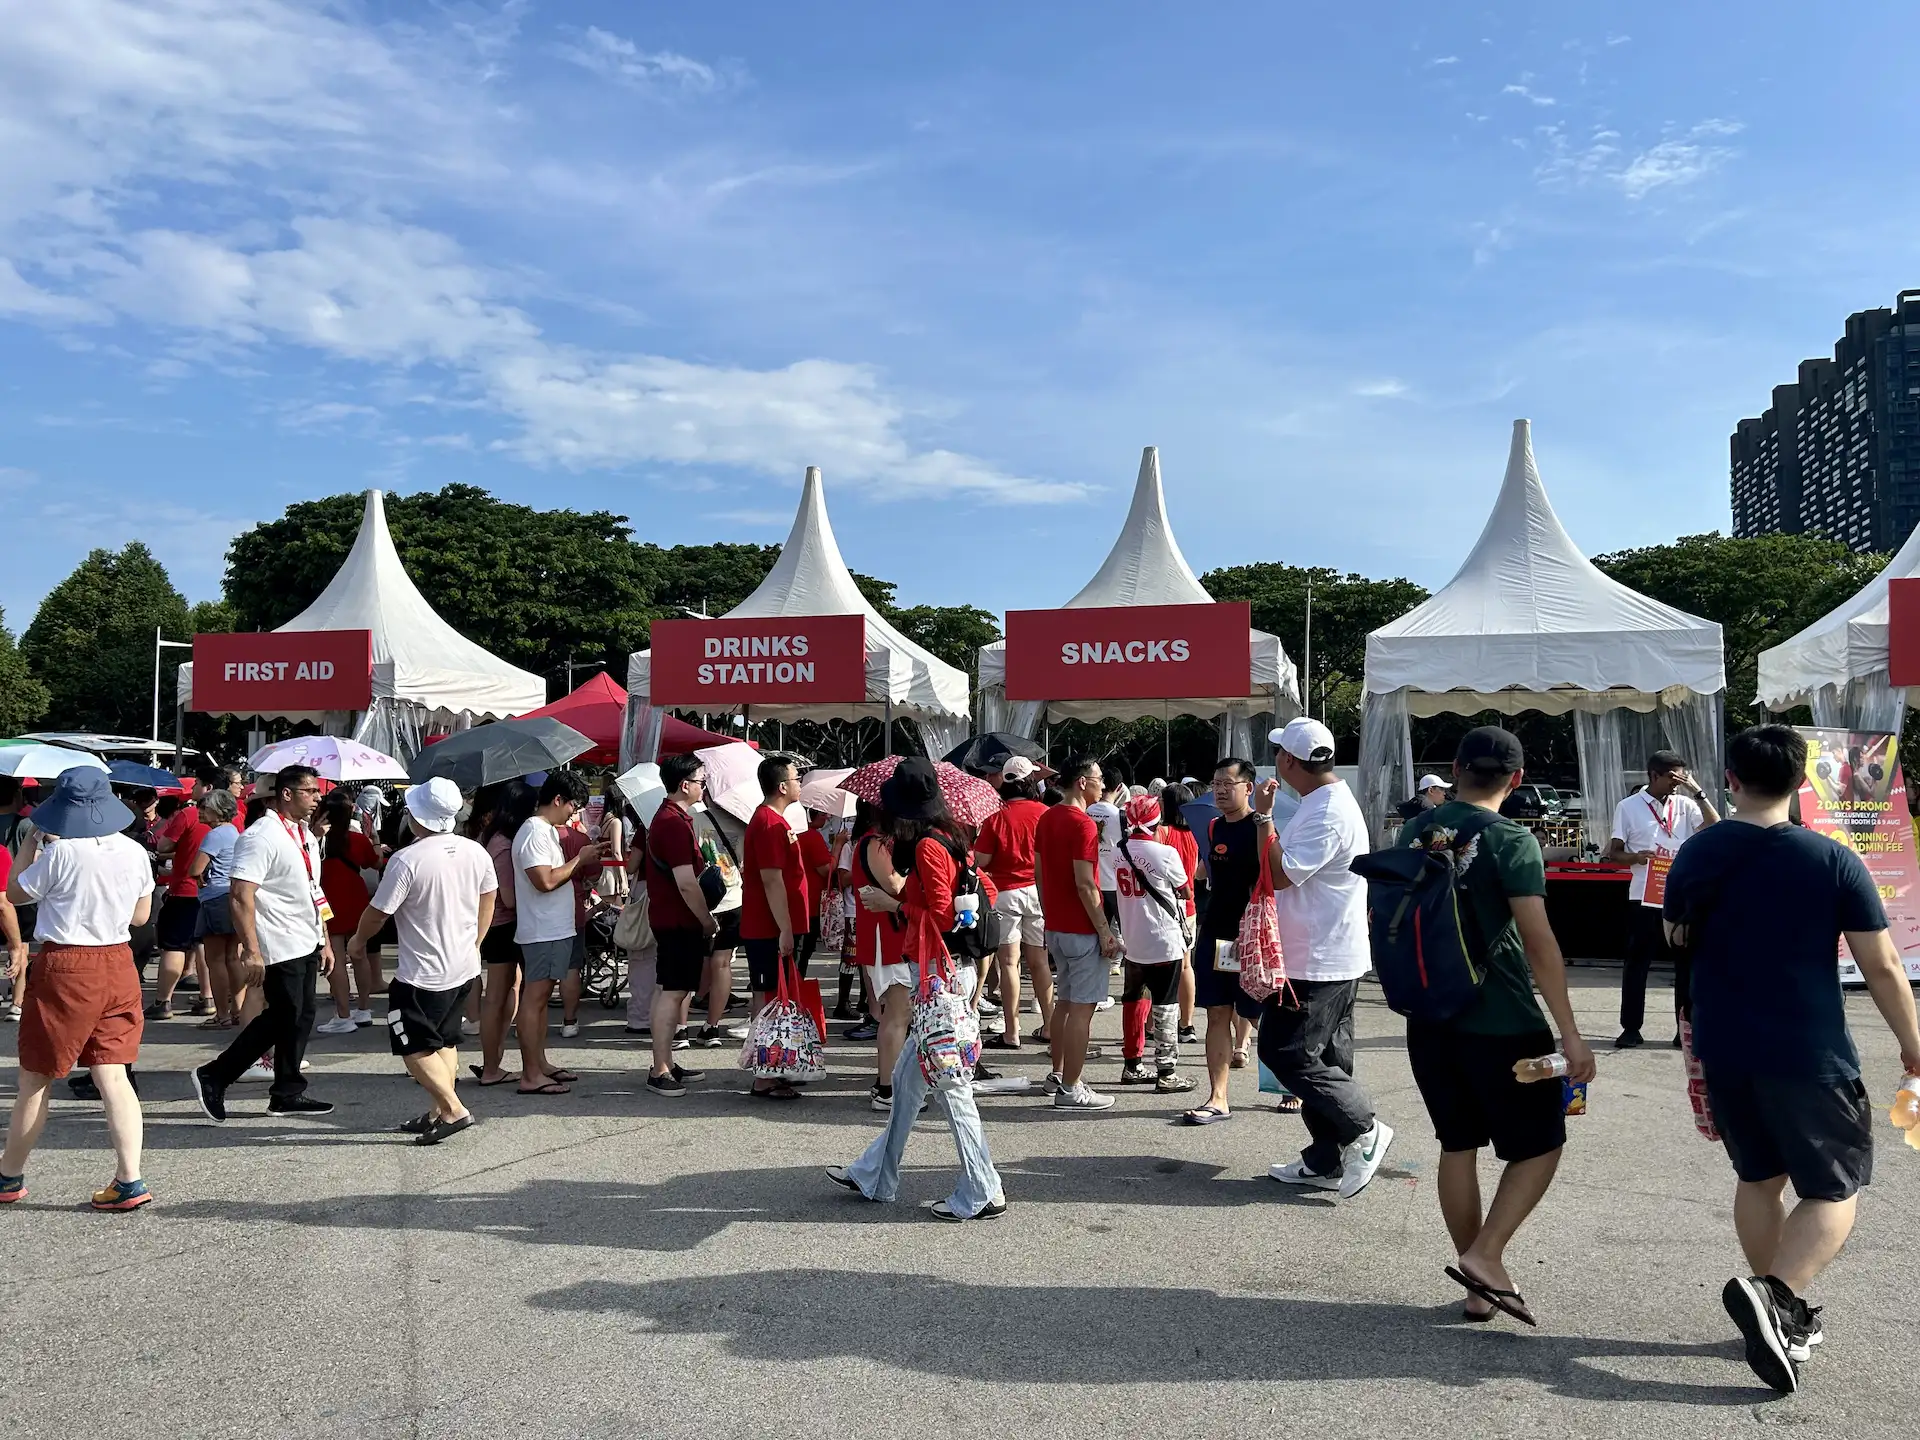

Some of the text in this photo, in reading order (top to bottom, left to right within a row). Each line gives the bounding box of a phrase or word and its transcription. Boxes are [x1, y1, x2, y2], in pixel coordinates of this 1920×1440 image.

[704, 635, 809, 658] DRINKS
[1061, 639, 1190, 665] SNACKS
[224, 661, 334, 681] FIRST AID
[697, 662, 815, 685] STATION
[1817, 800, 1893, 811] 2 DAYS PROMO!
[1850, 832, 1889, 842] JOINING
[1852, 842, 1904, 852] ADMIN FEE
